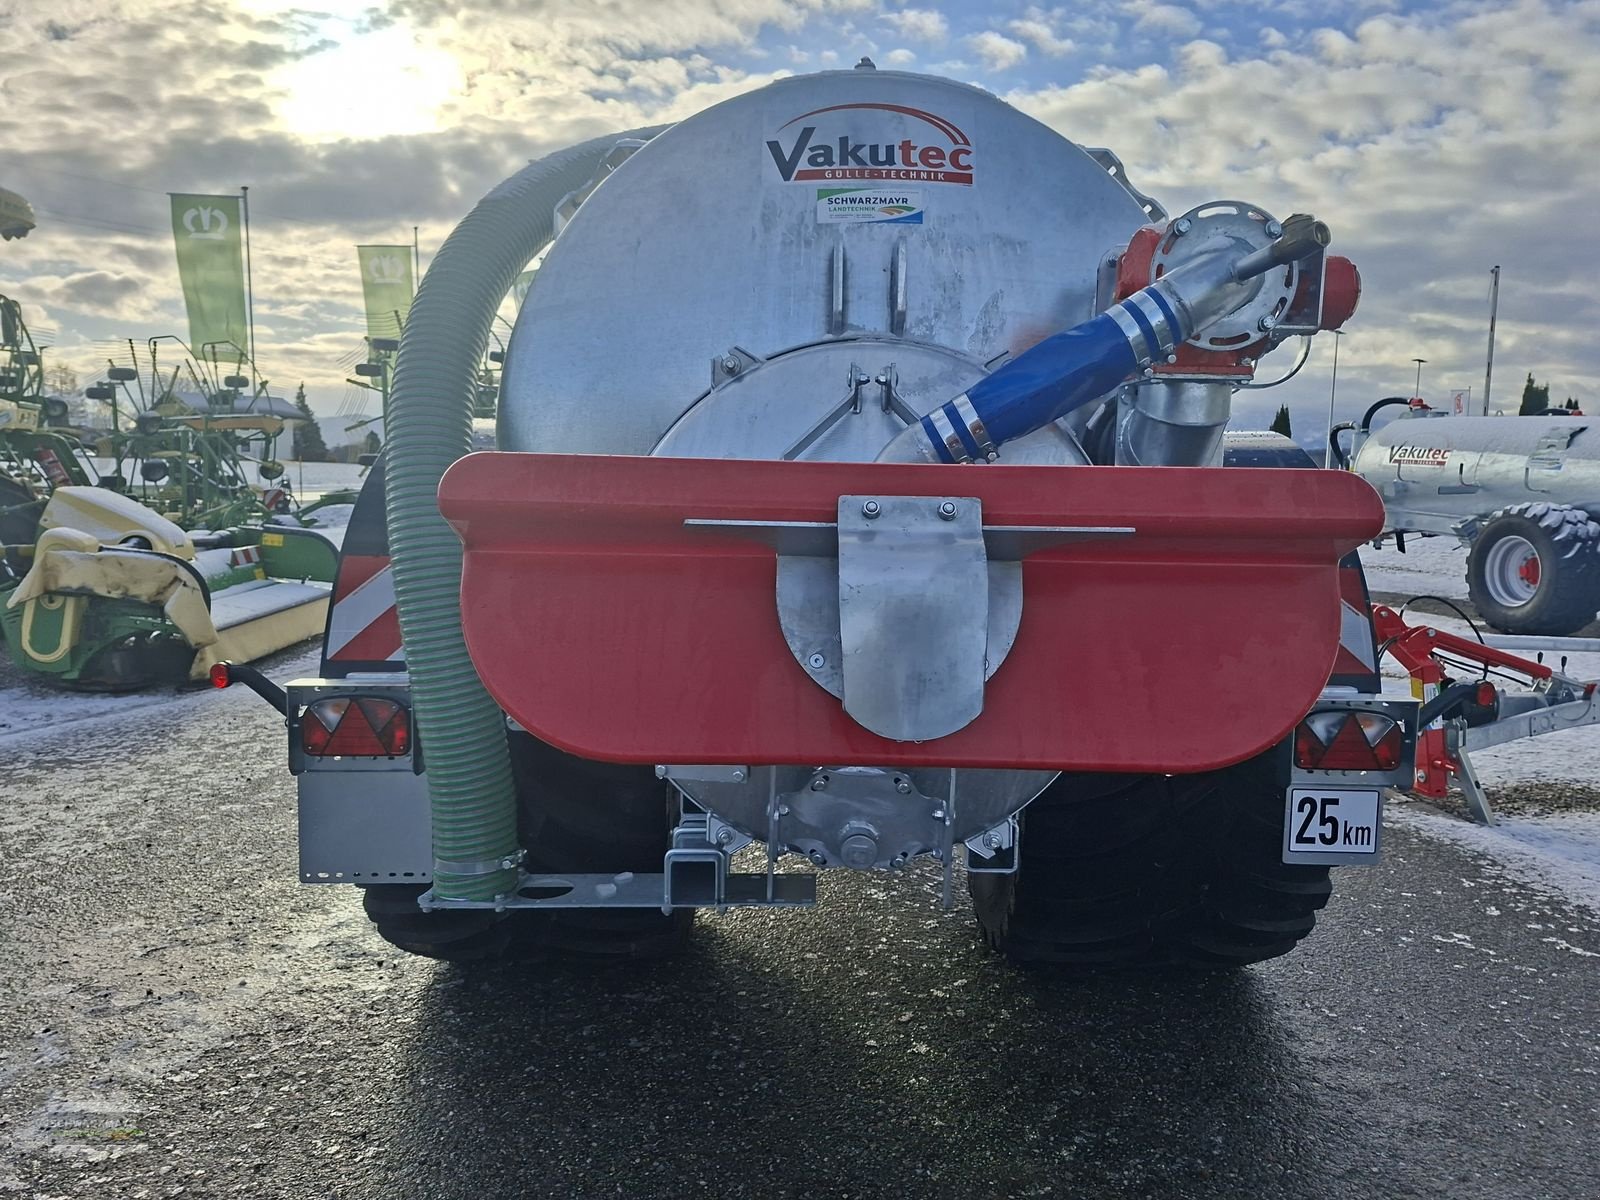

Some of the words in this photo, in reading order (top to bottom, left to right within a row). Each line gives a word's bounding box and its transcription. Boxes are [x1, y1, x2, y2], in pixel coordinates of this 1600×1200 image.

[766, 126, 974, 182] Vakutec
[827, 197, 909, 205] SCHWARZMAYR
[1389, 440, 1451, 463] Vakutec
[1295, 796, 1340, 845] 25
[1343, 820, 1371, 845] km
